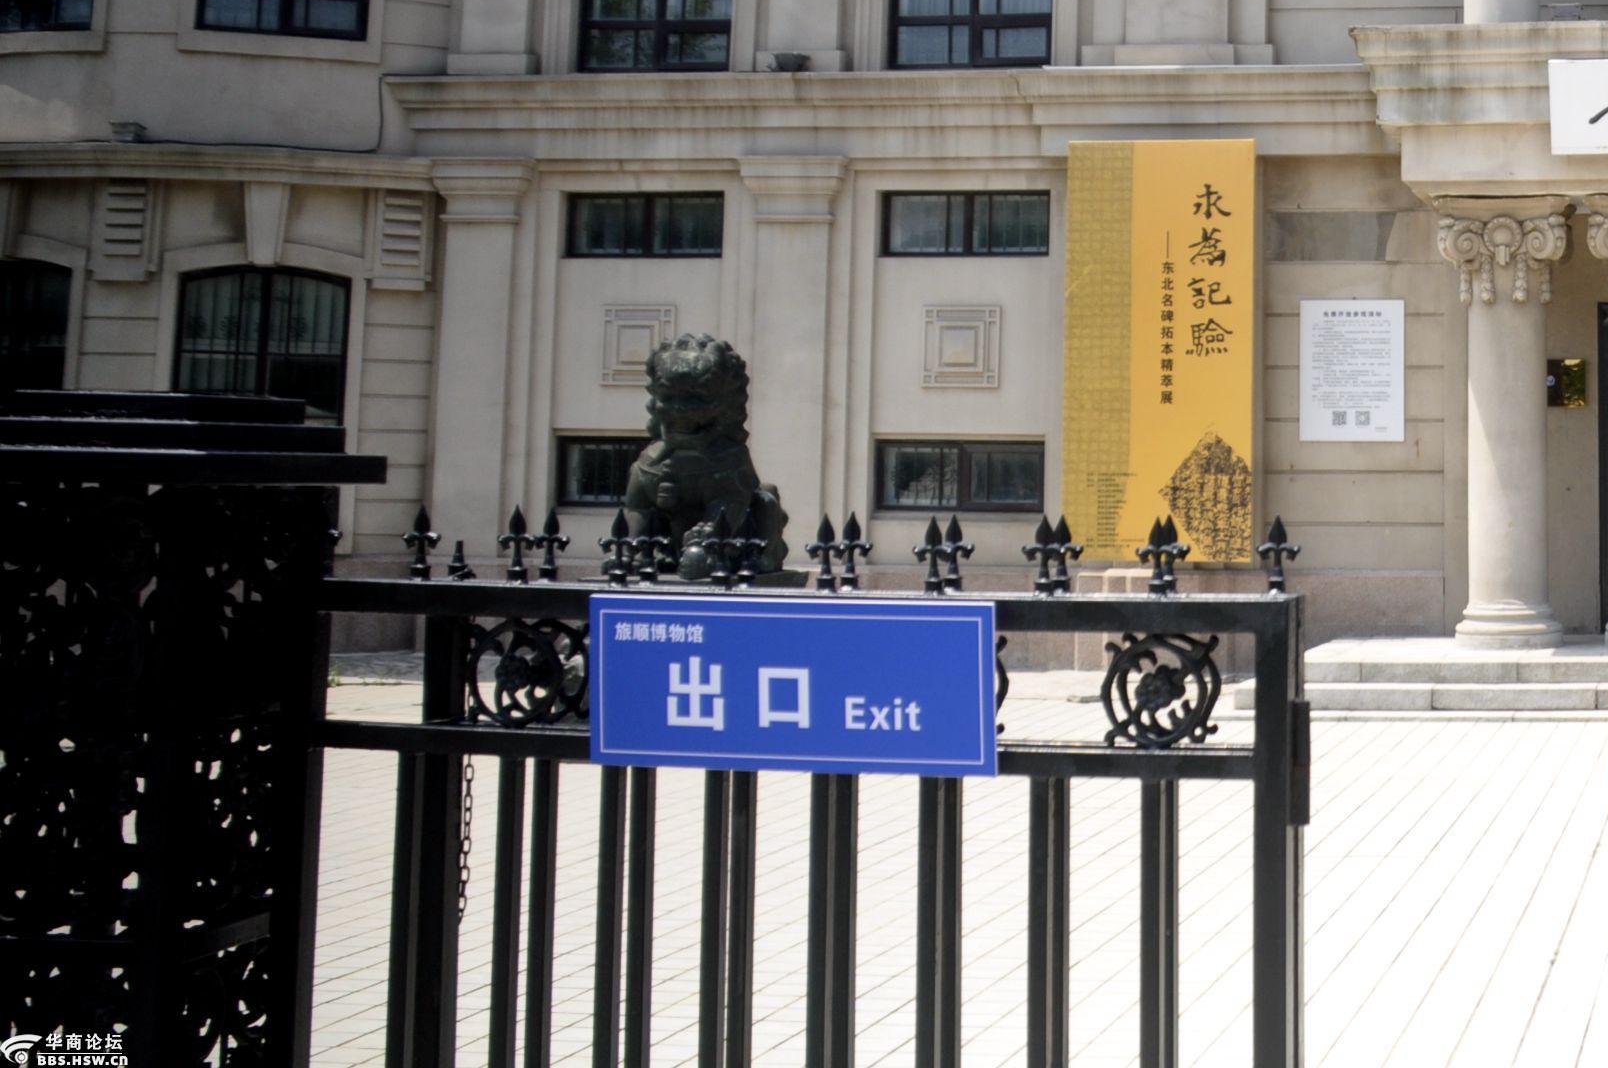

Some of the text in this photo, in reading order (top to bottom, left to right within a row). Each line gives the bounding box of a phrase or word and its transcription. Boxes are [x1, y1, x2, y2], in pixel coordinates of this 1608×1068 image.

[614, 622, 704, 643] 旅顺博物馆
[667, 655, 922, 732] 出口 Exit
